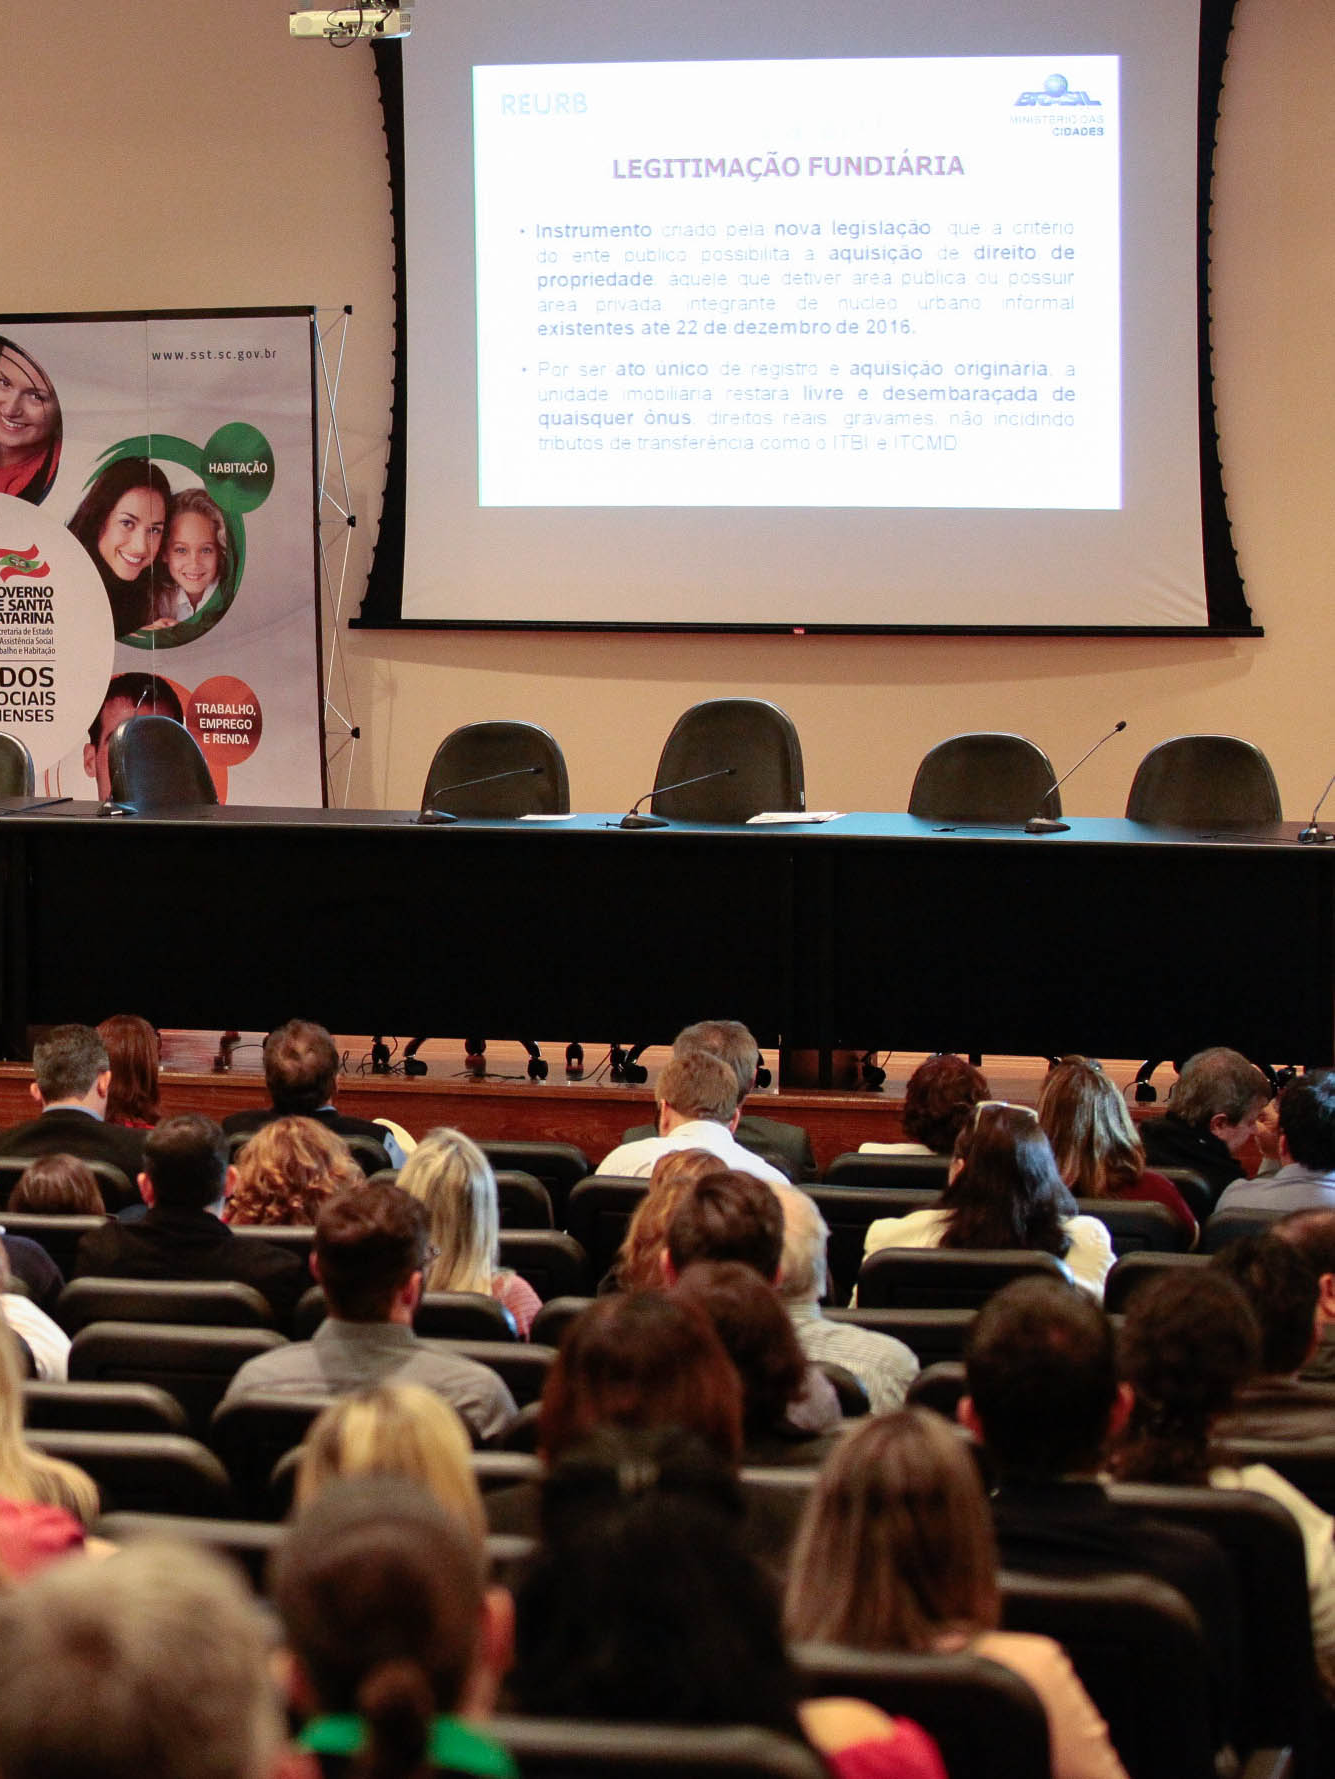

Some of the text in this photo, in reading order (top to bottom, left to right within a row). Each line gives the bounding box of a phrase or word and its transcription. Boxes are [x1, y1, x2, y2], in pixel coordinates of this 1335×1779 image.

[500, 92, 588, 115] REURB
[1052, 127, 1104, 136] CIDADES
[612, 149, 966, 182] LEGITIMAÇÃO FUNDIÁRIA
[536, 224, 652, 240] Instrumento
[727, 224, 764, 240] pela
[774, 224, 821, 236] nova
[948, 224, 980, 237] que
[994, 224, 1002, 235] a
[537, 248, 558, 263] do
[572, 248, 610, 263] ente
[702, 248, 790, 264] possibilita
[805, 249, 815, 260] a
[828, 244, 922, 264] aquisição
[938, 248, 962, 260] de
[1051, 244, 1074, 260] de
[738, 272, 770, 288] que
[978, 273, 998, 285] ou
[1009, 272, 1074, 287] possuir
[799, 296, 818, 310] de
[919, 296, 980, 310] urbano
[1002, 294, 1074, 310] informal
[538, 321, 634, 336] existentes
[676, 320, 698, 336] 22
[704, 320, 730, 335] de
[733, 320, 832, 335] dezembro
[836, 320, 860, 334] de
[866, 318, 915, 334] 2016.
[152, 348, 277, 361] www.sst.sc.gov.br
[538, 361, 569, 376] Por
[580, 365, 606, 376] ser
[616, 362, 646, 376] ato
[722, 361, 741, 376] de
[752, 362, 818, 380] registro
[830, 364, 840, 375] e
[850, 360, 943, 379] aquisição
[1066, 365, 1075, 376] a
[538, 386, 610, 401] unidade
[803, 385, 844, 400] livre
[858, 388, 868, 400] e
[883, 385, 1037, 405] desembaraçada
[1052, 386, 1076, 402] de
[538, 410, 634, 430] quaisquer
[711, 411, 773, 424] direitos
[950, 410, 982, 425] não
[994, 411, 1074, 425] incidindo
[539, 436, 603, 450] tributos
[610, 435, 632, 450] de
[637, 435, 754, 450] transferência
[761, 438, 810, 450] como
[817, 439, 826, 450] o
[834, 435, 867, 450] ITBI
[877, 439, 887, 450] e
[209, 460, 268, 476] HABITAÇÃO
[8, 599, 54, 612] SANTA
[23, 627, 32, 636] de
[32, 627, 54, 636] Estado
[0, 636, 35, 645] Assistência
[36, 637, 54, 645] Social
[23, 646, 56, 656] Habitação
[0, 667, 55, 688] DOS
[195, 703, 256, 716] TRABALHO,
[199, 718, 253, 730] EMPREGO
[203, 733, 250, 744] E RENDA
